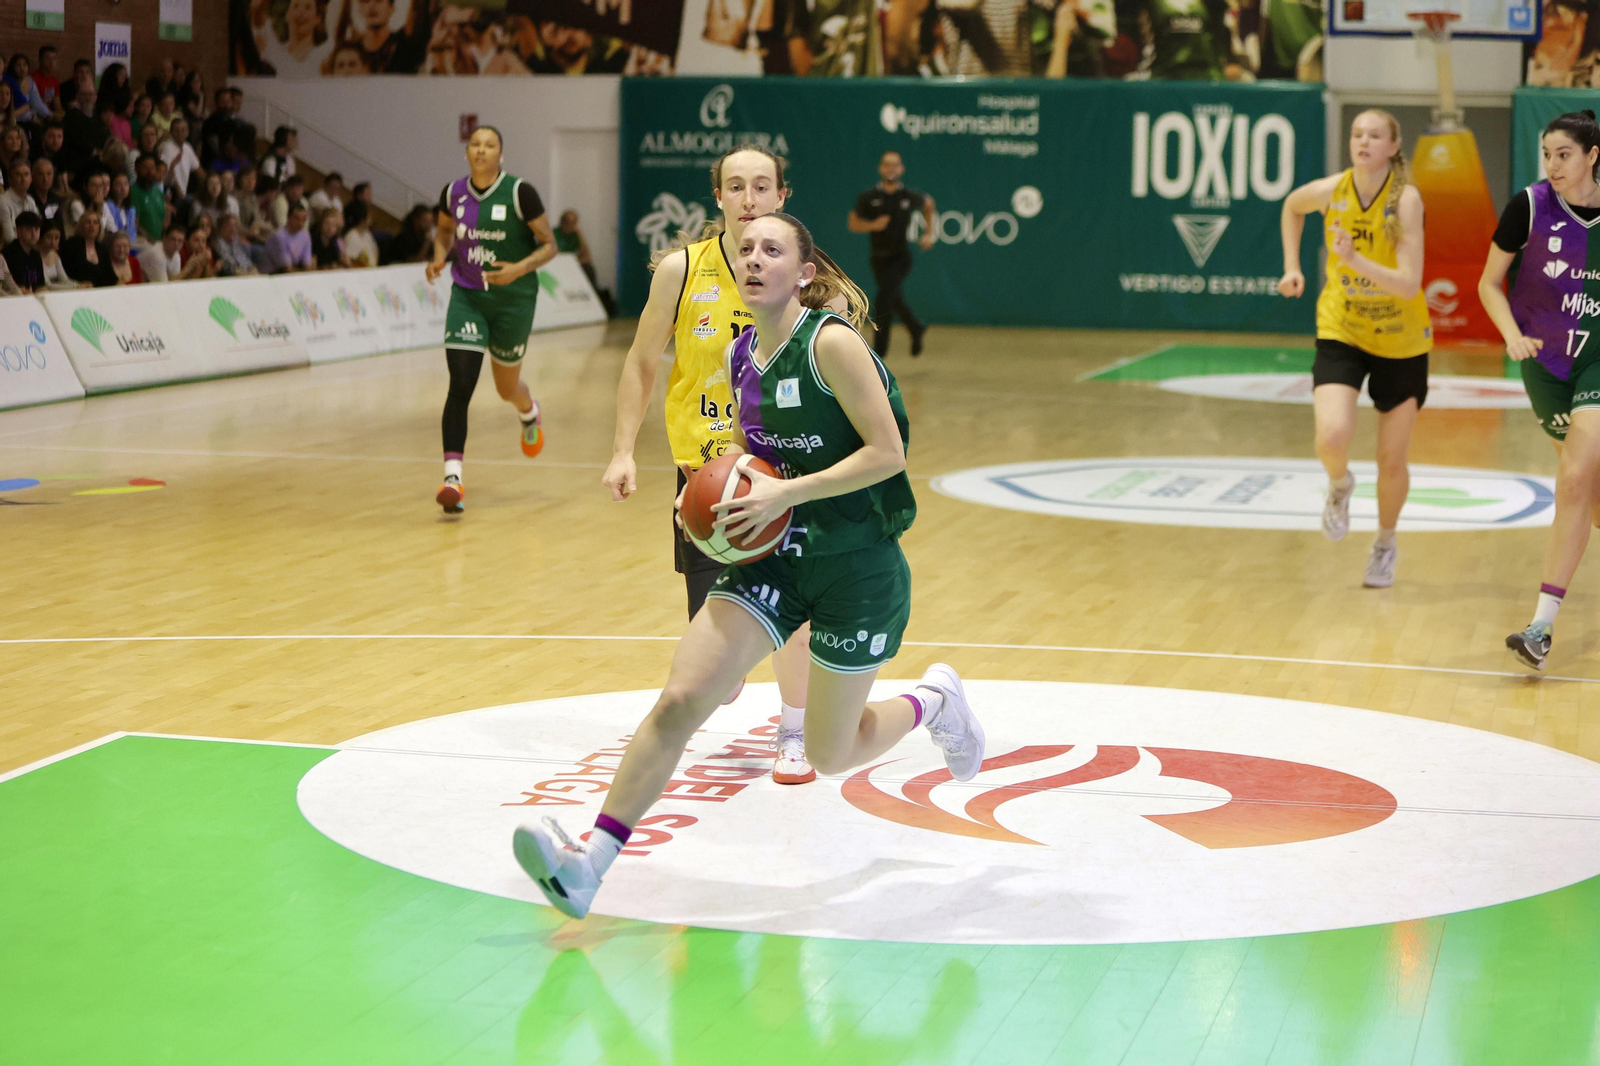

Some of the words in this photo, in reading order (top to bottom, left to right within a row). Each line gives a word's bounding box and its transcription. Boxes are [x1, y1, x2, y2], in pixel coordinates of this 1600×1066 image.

[1119, 273, 1206, 294] VERTIGO
[248, 318, 290, 341] Unicaja
[116, 330, 165, 356] Unicaja
[1566, 329, 1590, 358] 17
[701, 394, 718, 418] la
[710, 420, 725, 431] de
[749, 432, 824, 453] Unicaja
